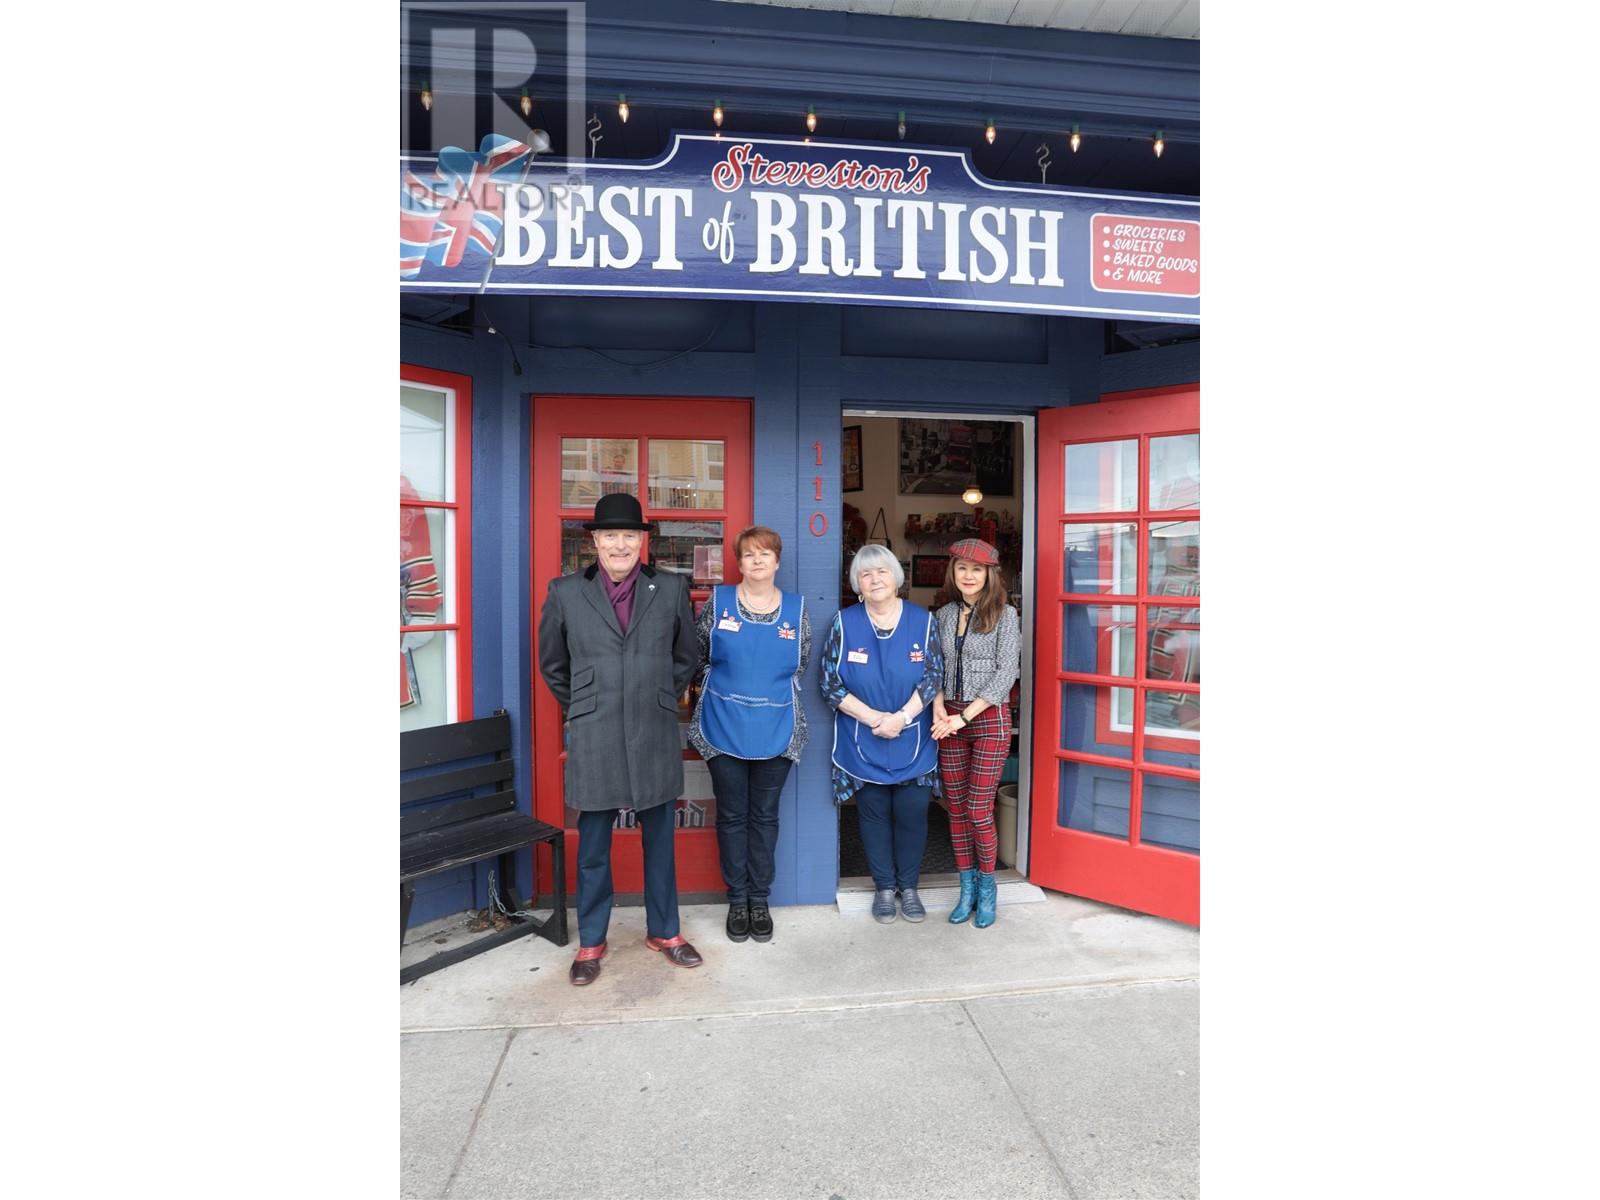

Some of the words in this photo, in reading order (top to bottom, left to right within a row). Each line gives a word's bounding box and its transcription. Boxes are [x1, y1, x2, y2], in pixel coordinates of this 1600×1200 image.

[711, 143, 932, 194] Steveston's
[495, 184, 694, 271] BEST
[702, 200, 735, 265] of
[749, 191, 1065, 288] BRITISH
[1112, 224, 1186, 242] GROCERIES
[1112, 239, 1164, 254] SWEETS
[1113, 253, 1154, 267] BAKED
[1156, 257, 1198, 273] GOODS
[1112, 267, 1124, 281] &
[1127, 269, 1165, 285] MORE
